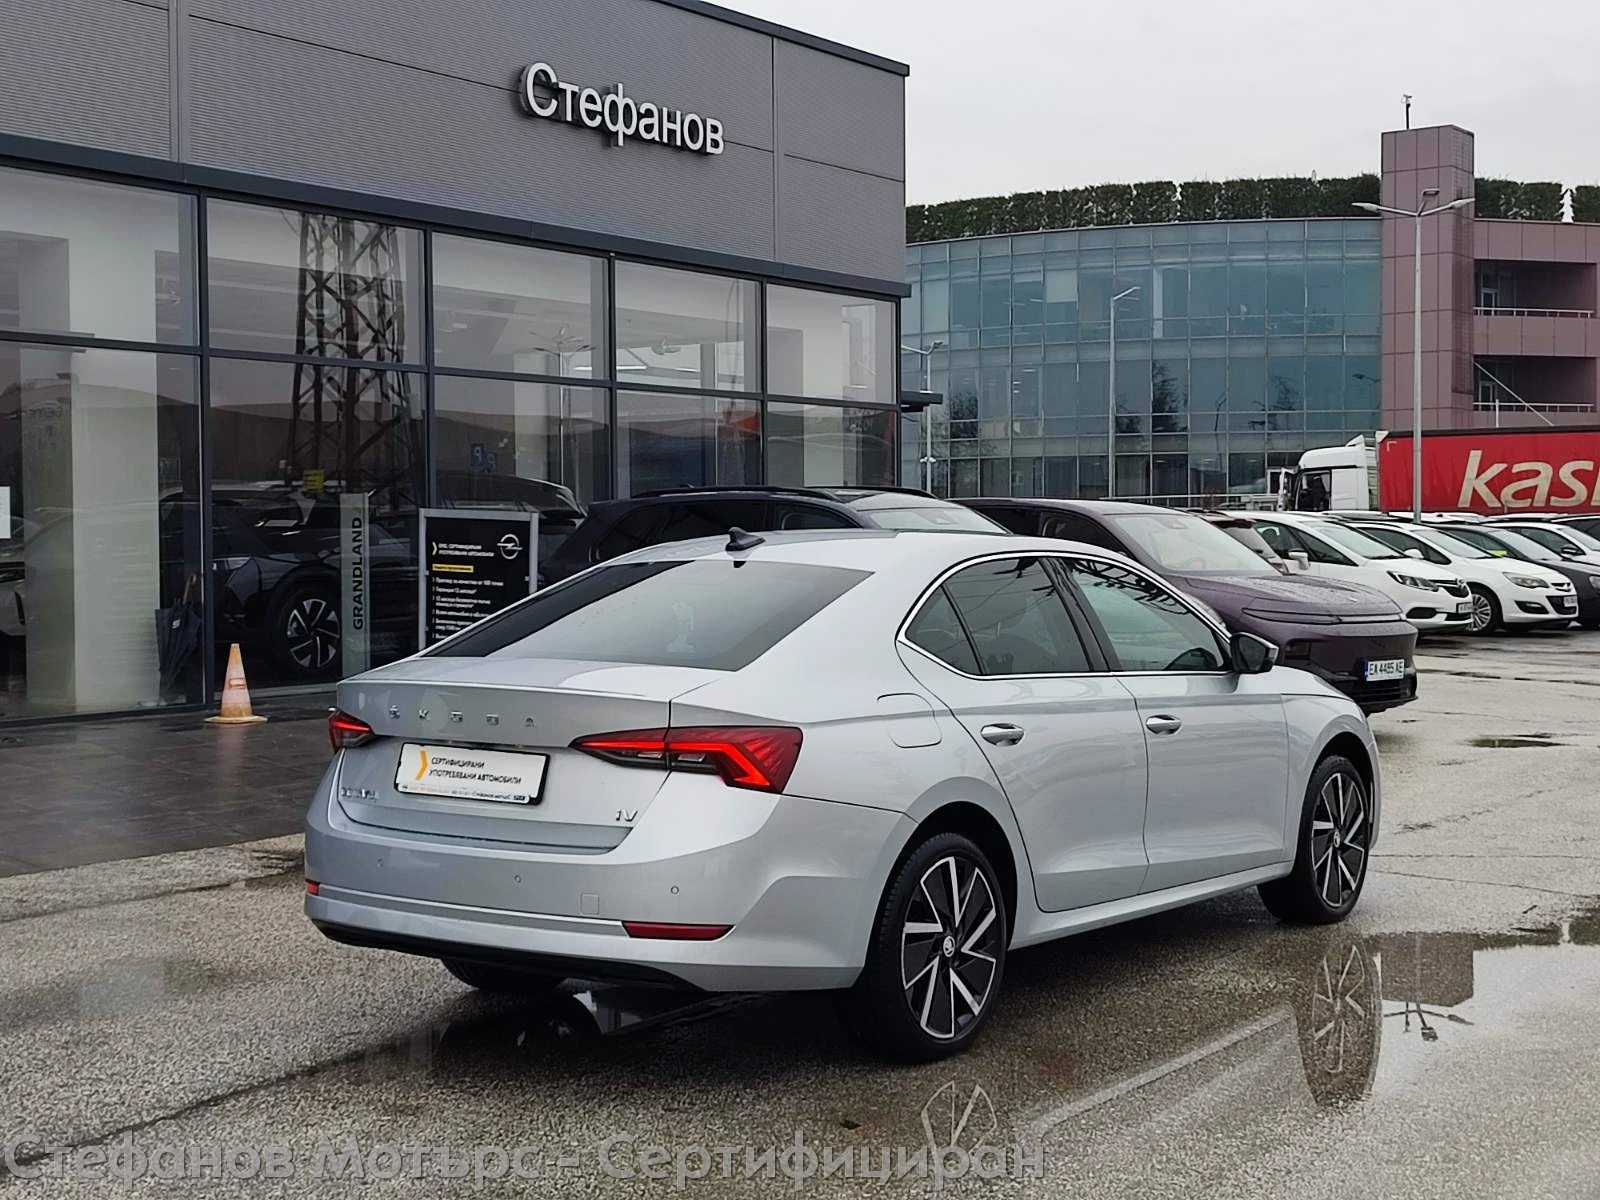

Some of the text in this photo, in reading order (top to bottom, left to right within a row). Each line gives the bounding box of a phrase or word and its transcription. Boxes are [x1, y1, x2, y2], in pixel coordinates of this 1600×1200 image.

[525, 62, 724, 154] Стефанов
[1457, 449, 1600, 508] kas
[352, 517, 363, 630] GRANDLAND
